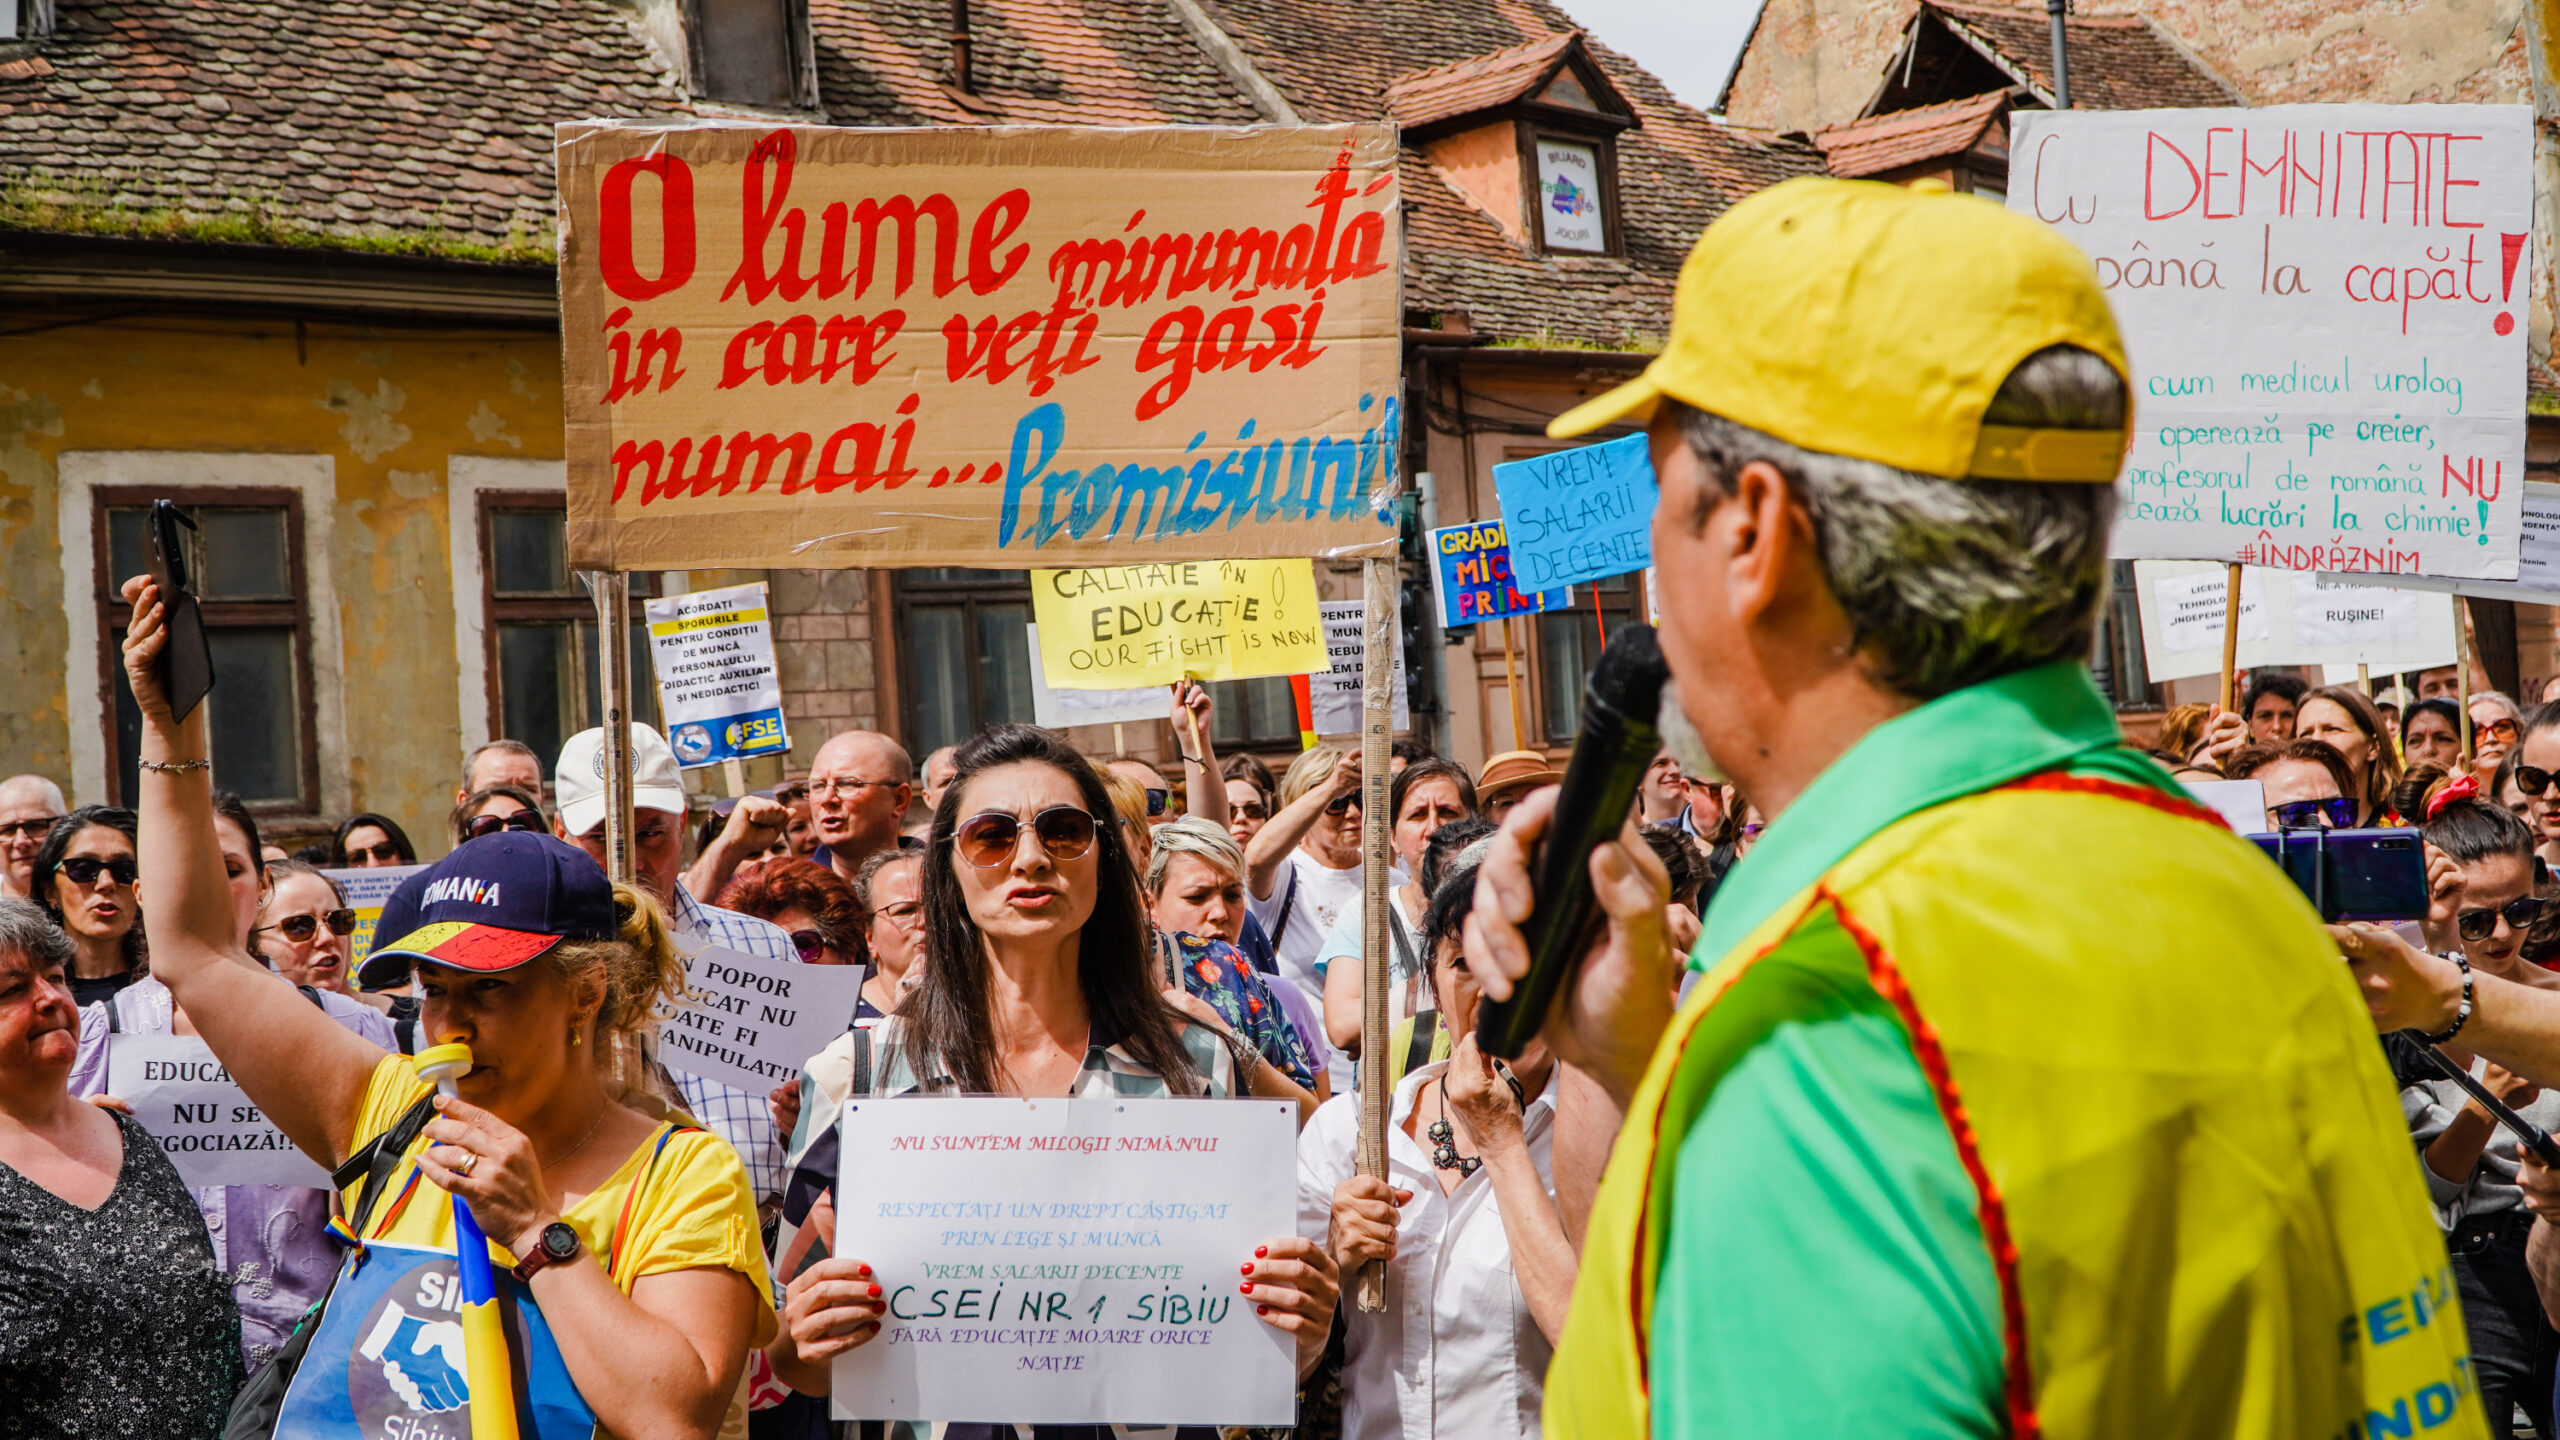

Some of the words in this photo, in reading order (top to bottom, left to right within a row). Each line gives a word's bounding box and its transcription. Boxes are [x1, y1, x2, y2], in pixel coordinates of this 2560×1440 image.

[2034, 133, 2096, 224] Cu
[2144, 127, 2484, 228] DEMNITATE
[599, 152, 697, 302] O
[719, 128, 1031, 306] lume
[2095, 240, 2226, 290] până
[2262, 223, 2311, 296] la
[714, 308, 906, 391] care
[941, 292, 1101, 397] veți
[2148, 376, 2214, 397] cum
[2240, 355, 2350, 394] medicul
[2374, 356, 2462, 416] urolog
[2159, 413, 2283, 462] operează
[2307, 419, 2335, 457] pe
[2356, 413, 2435, 451] creier,
[998, 392, 1400, 550] Promisiuni!
[1527, 447, 1613, 489] VREM
[2127, 451, 2251, 504] profesorul
[2275, 459, 2309, 492] de
[2330, 463, 2427, 496] română
[2440, 454, 2501, 502] NU
[1517, 482, 1636, 549] SALARII
[2119, 488, 2204, 522] tează
[2220, 490, 2306, 529] lucrări
[2332, 493, 2361, 531] la
[2384, 499, 2490, 547] chimie!
[1440, 520, 1508, 555] GRĂDI
[1456, 551, 1516, 586] MIC
[1527, 528, 1649, 585] DECENTE
[1053, 563, 1199, 598] CALITATE
[1219, 560, 1246, 584] ÎN
[2191, 582, 2227, 595] LICEUL
[676, 600, 733, 617] ACORDAȚI
[1321, 609, 1363, 621] PENTR
[677, 613, 740, 631] SPORURILE
[1332, 626, 1363, 638] MUN
[660, 633, 704, 648] PENTRU
[707, 625, 759, 640] CONDIȚII
[683, 648, 697, 658] DE
[700, 640, 740, 656] MUNCĂ
[1069, 642, 1137, 670] OUR
[1144, 634, 1231, 661] FIGHT
[1240, 628, 1262, 650] IS
[1272, 626, 1319, 648] NOW
[672, 654, 756, 675] PERSONALULUI
[665, 674, 715, 690] DIDACTIC
[718, 666, 772, 682] AUXILIAR
[676, 692, 687, 704] ȘI
[690, 681, 760, 701] NEDIDACTIC!
[742, 717, 779, 738] FSE
[704, 961, 792, 998] POPOR
[760, 1005, 797, 1027] NU
[734, 1026, 759, 1047] FI
[659, 1028, 797, 1082] ANIPULAT!!
[144, 1061, 239, 1087] EDUCA
[173, 1103, 219, 1124] NU
[231, 1106, 261, 1123] SE
[890, 1135, 926, 1151] NU
[930, 1133, 1021, 1151] SUNTEM
[1026, 1135, 1112, 1155] MILOGII
[1115, 1134, 1219, 1152] NIMĂNUI
[877, 1200, 1003, 1221] RESPECTAȚI
[1007, 1201, 1044, 1218] UN
[1049, 1201, 1125, 1219] DREPT
[941, 1230, 998, 1246] PRIN
[1000, 1230, 1054, 1249] LEGE
[1057, 1231, 1078, 1249] ȘI
[1081, 1230, 1162, 1247] MUNCĂ
[920, 1262, 984, 1279] VREM
[989, 1263, 1079, 1280] SALARII
[1084, 1263, 1184, 1280] DECENTE
[416, 1271, 463, 1313] SI
[890, 1281, 1004, 1322] CSEI
[1018, 1291, 1072, 1322] NR
[1087, 1295, 1107, 1323] 1
[1127, 1284, 1230, 1324] SIBIU
[888, 1326, 942, 1345] FĂRĂ
[950, 1328, 1059, 1347] EDUCAȚIE
[1063, 1328, 1145, 1344] MOARE
[1149, 1329, 1213, 1345] ORICE
[1016, 1355, 1085, 1373] NAȚIE
